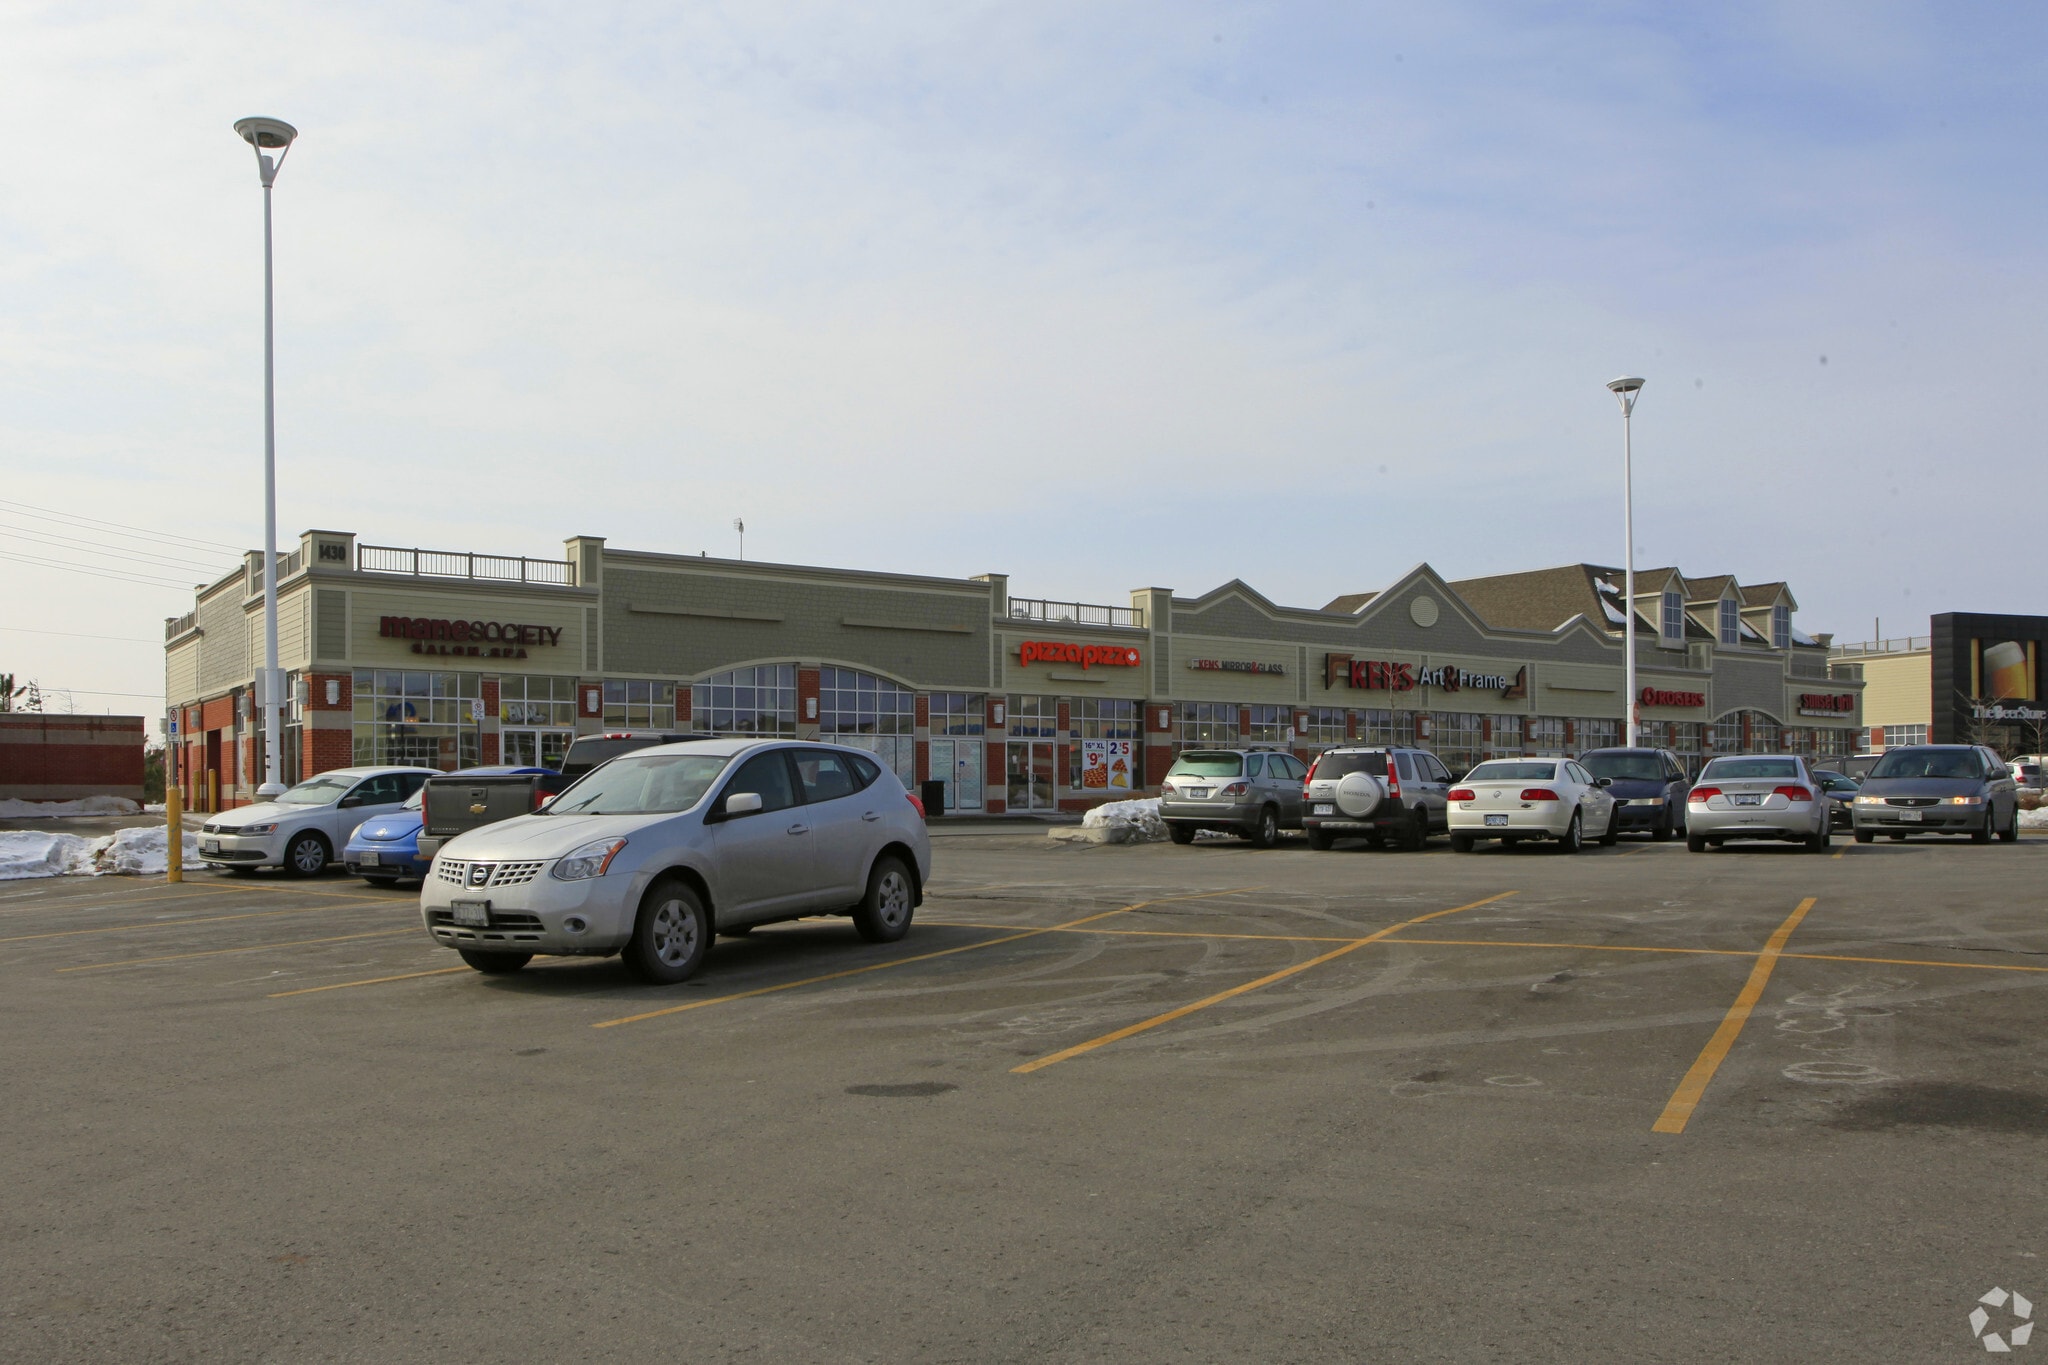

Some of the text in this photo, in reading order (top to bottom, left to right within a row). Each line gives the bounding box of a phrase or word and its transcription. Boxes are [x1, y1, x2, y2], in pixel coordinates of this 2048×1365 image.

[319, 544, 346, 560] 1430
[1350, 660, 1415, 691] KENS
[1656, 690, 1705, 707] ROGERS
[1343, 790, 1371, 798] HONDA
